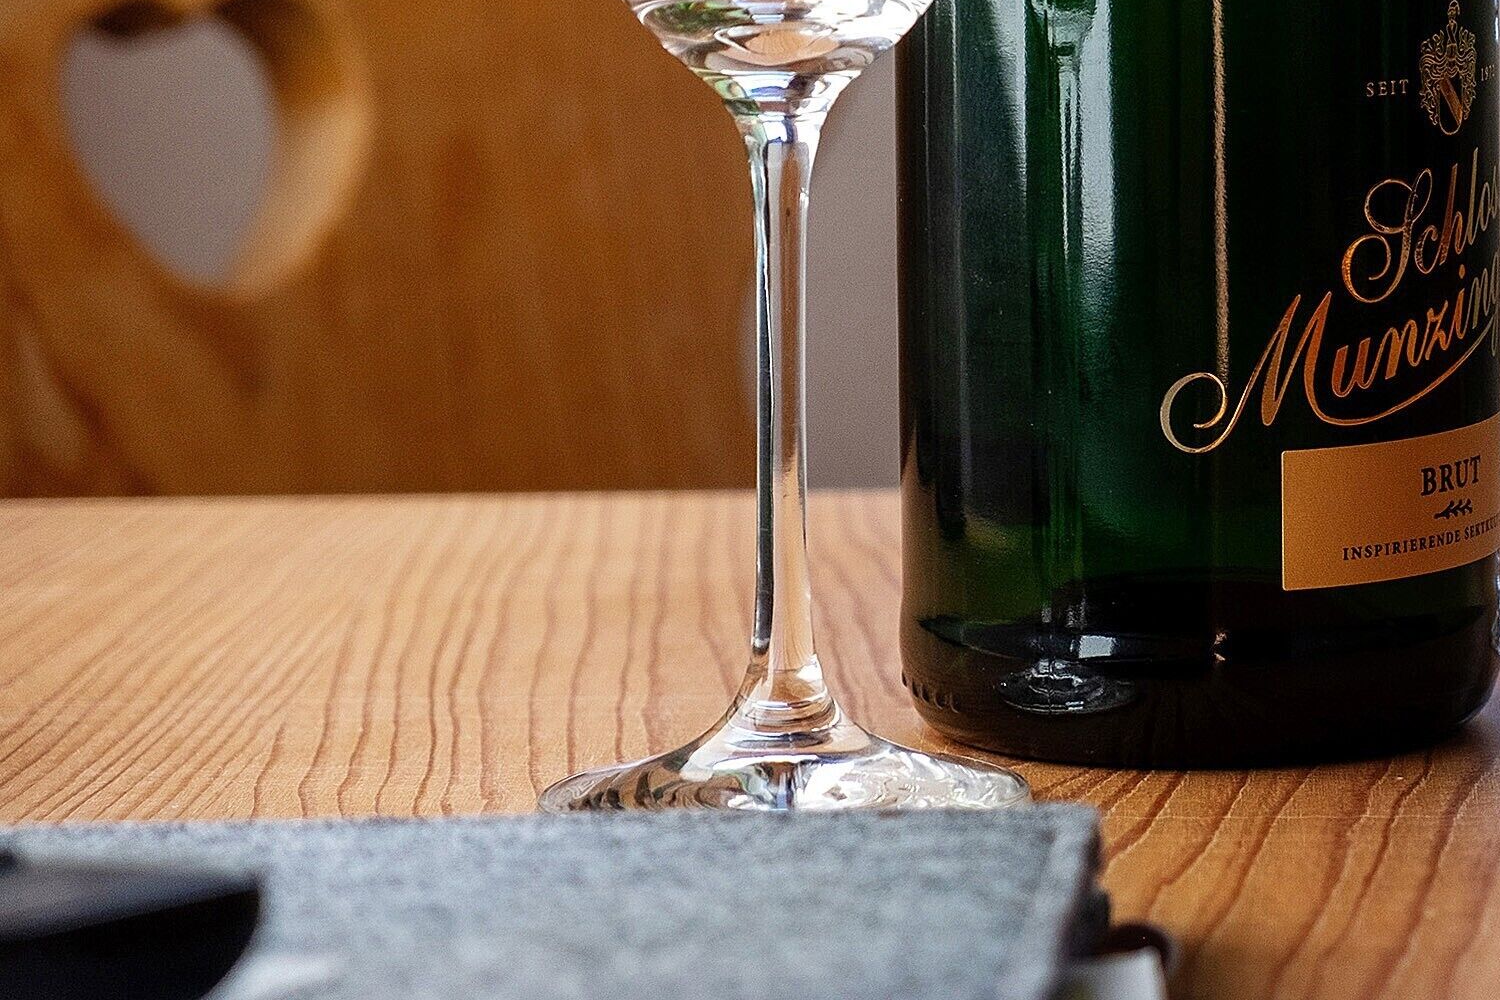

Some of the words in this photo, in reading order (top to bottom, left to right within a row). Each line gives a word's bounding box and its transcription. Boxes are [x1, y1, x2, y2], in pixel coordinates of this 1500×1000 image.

[1366, 79, 1409, 98] SEIT
[1421, 455, 1481, 496] BRUT
[1342, 530, 1461, 561] INSPIRIERENDE
